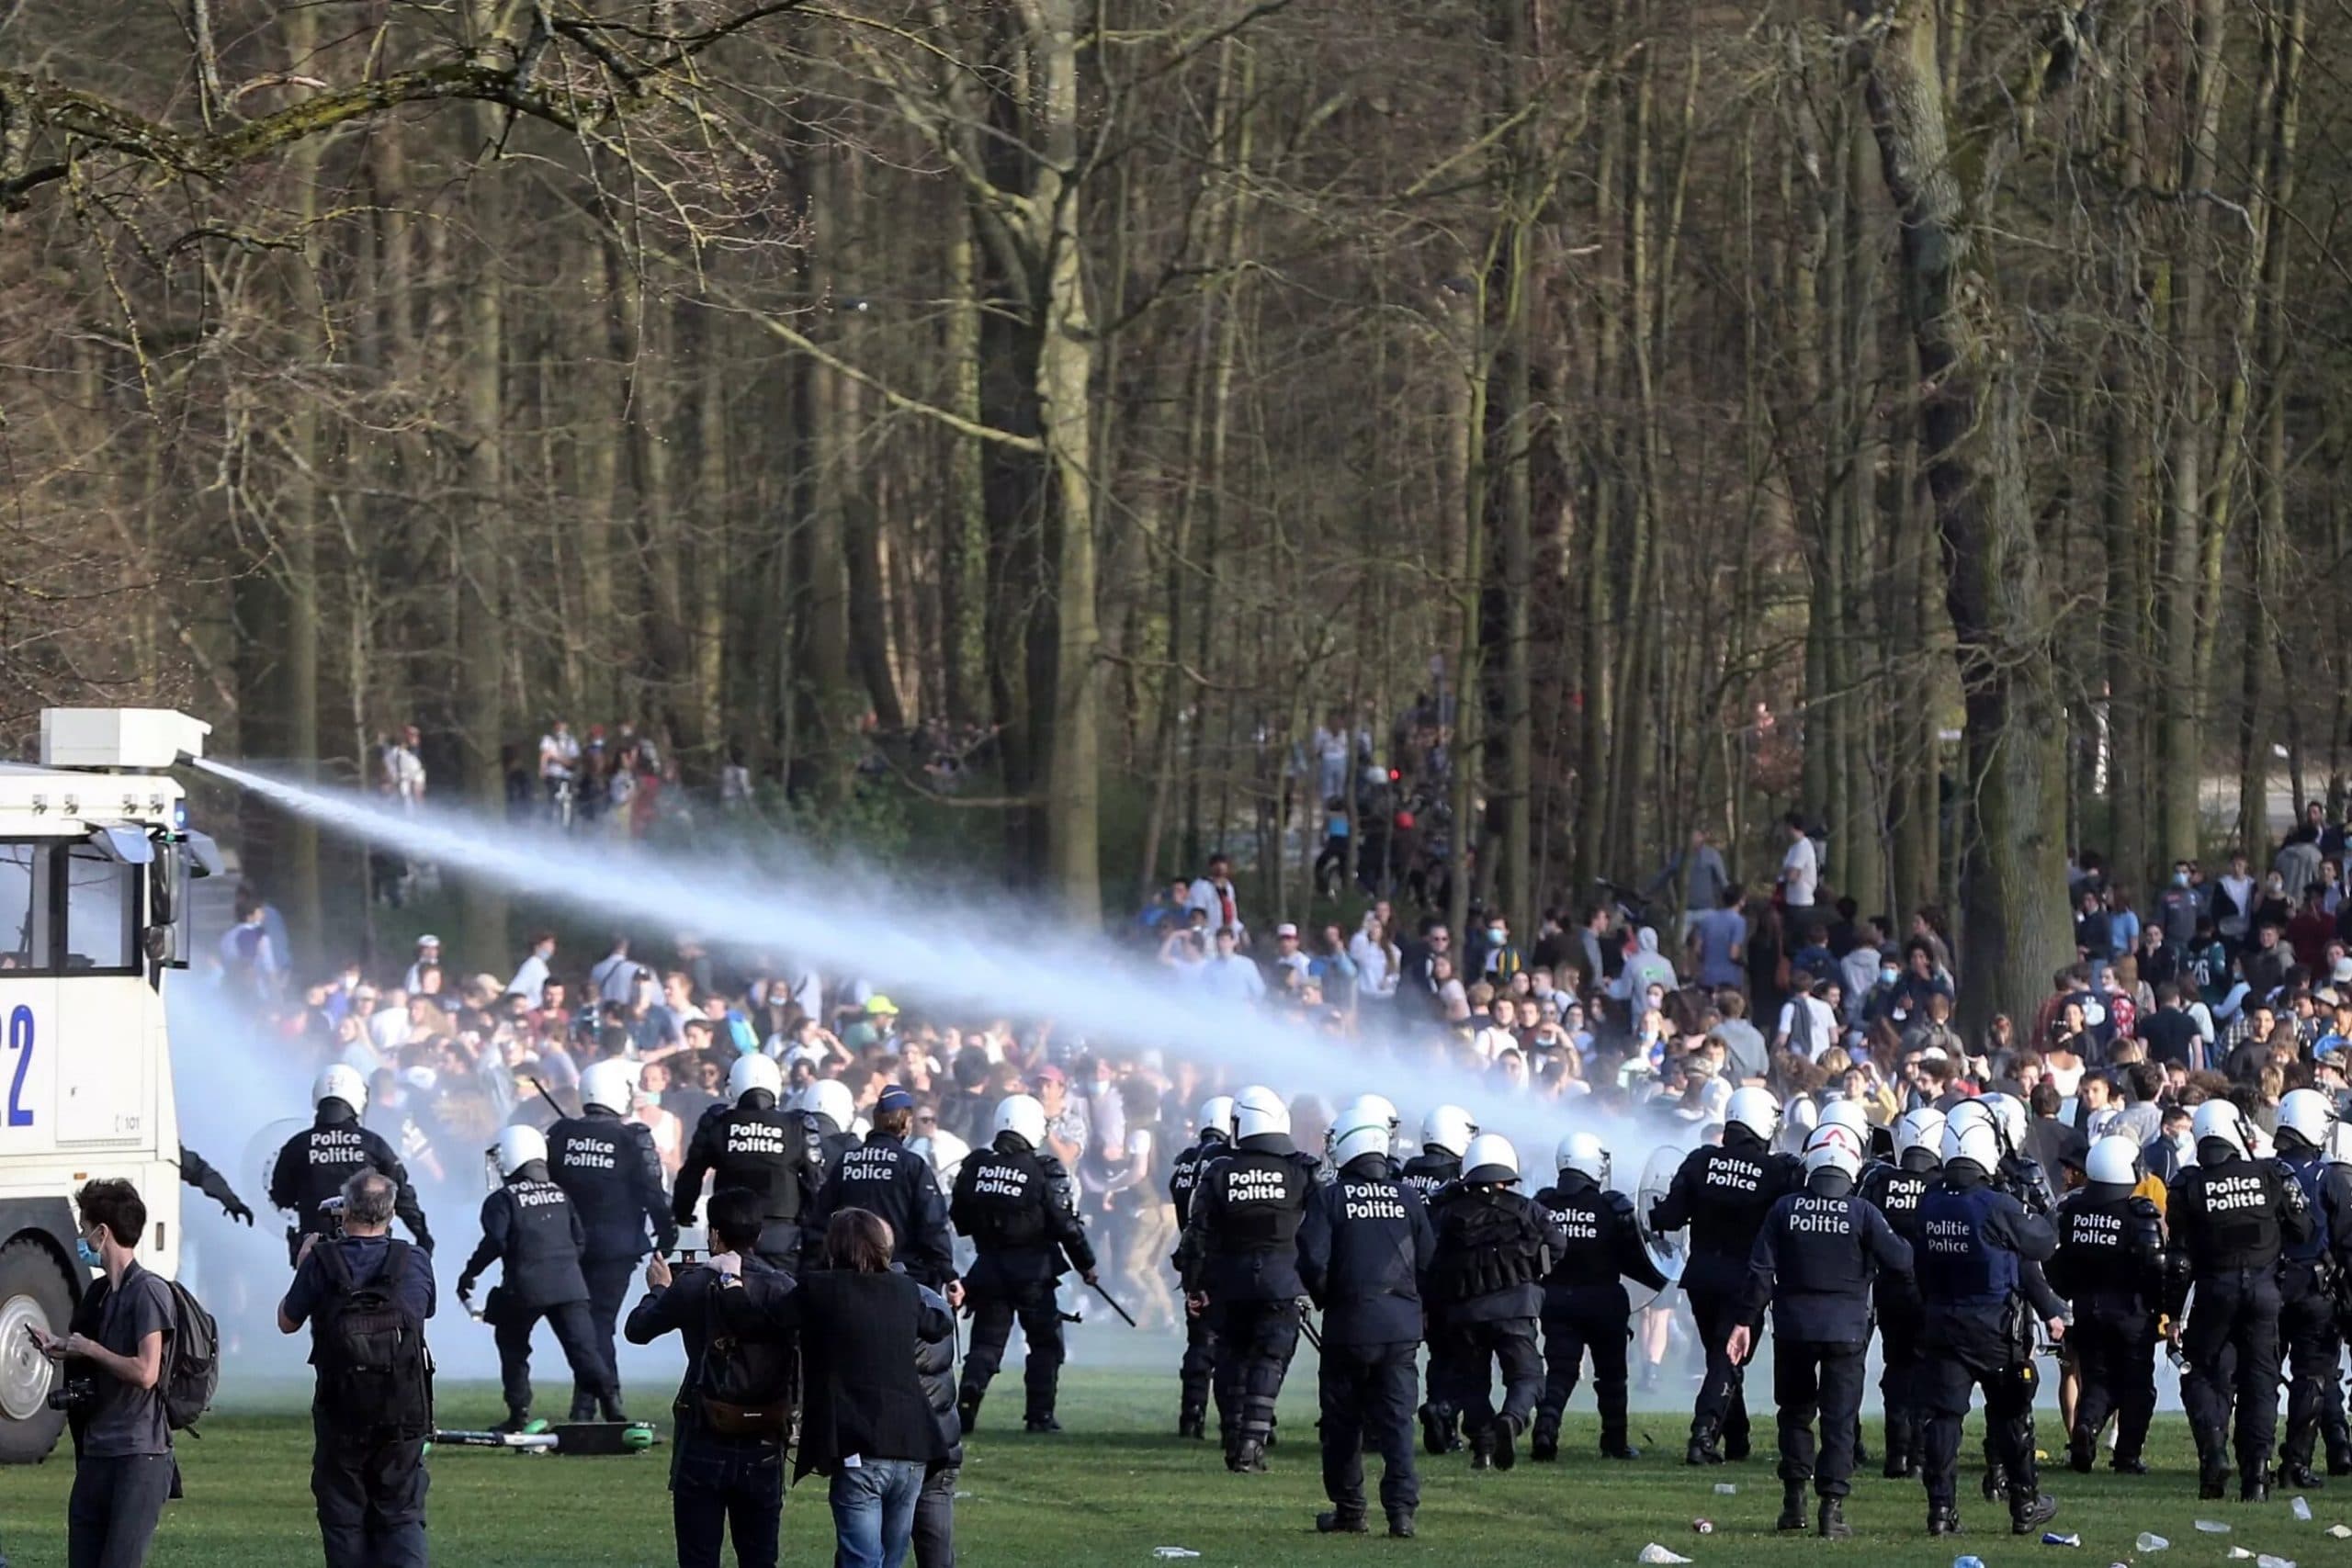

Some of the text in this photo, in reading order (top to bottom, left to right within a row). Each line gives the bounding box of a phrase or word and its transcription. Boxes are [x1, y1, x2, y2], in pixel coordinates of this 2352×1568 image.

[0, 1004, 34, 1126] 2
[311, 1131, 362, 1146] Police
[729, 1122, 783, 1139] Police
[567, 1138, 615, 1154] Police
[728, 1138, 785, 1154] Politie
[309, 1147, 364, 1164] Politie
[564, 1154, 616, 1168] Politie
[842, 1147, 898, 1164] Politie
[842, 1165, 893, 1181] Police
[978, 1166, 1028, 1184] Politie
[1709, 1157, 1762, 1178] Politie
[1229, 1169, 1283, 1186] Police
[1706, 1172, 1758, 1191] Police
[975, 1179, 1022, 1197] Police
[1228, 1185, 1285, 1202] Politie
[1344, 1182, 1398, 1199] Police
[2206, 1177, 2261, 1196] Police
[518, 1190, 565, 1207] Police
[1794, 1197, 1848, 1213] Police
[2207, 1193, 2266, 1213] Politie
[1346, 1200, 1405, 1219] Politie
[1790, 1214, 1849, 1234] Politie
[1927, 1220, 1970, 1235] Politie
[2074, 1213, 2121, 1229] Politie
[1558, 1224, 1597, 1238] litie
[2073, 1230, 2117, 1246] Police
[1928, 1238, 1968, 1253] Police
